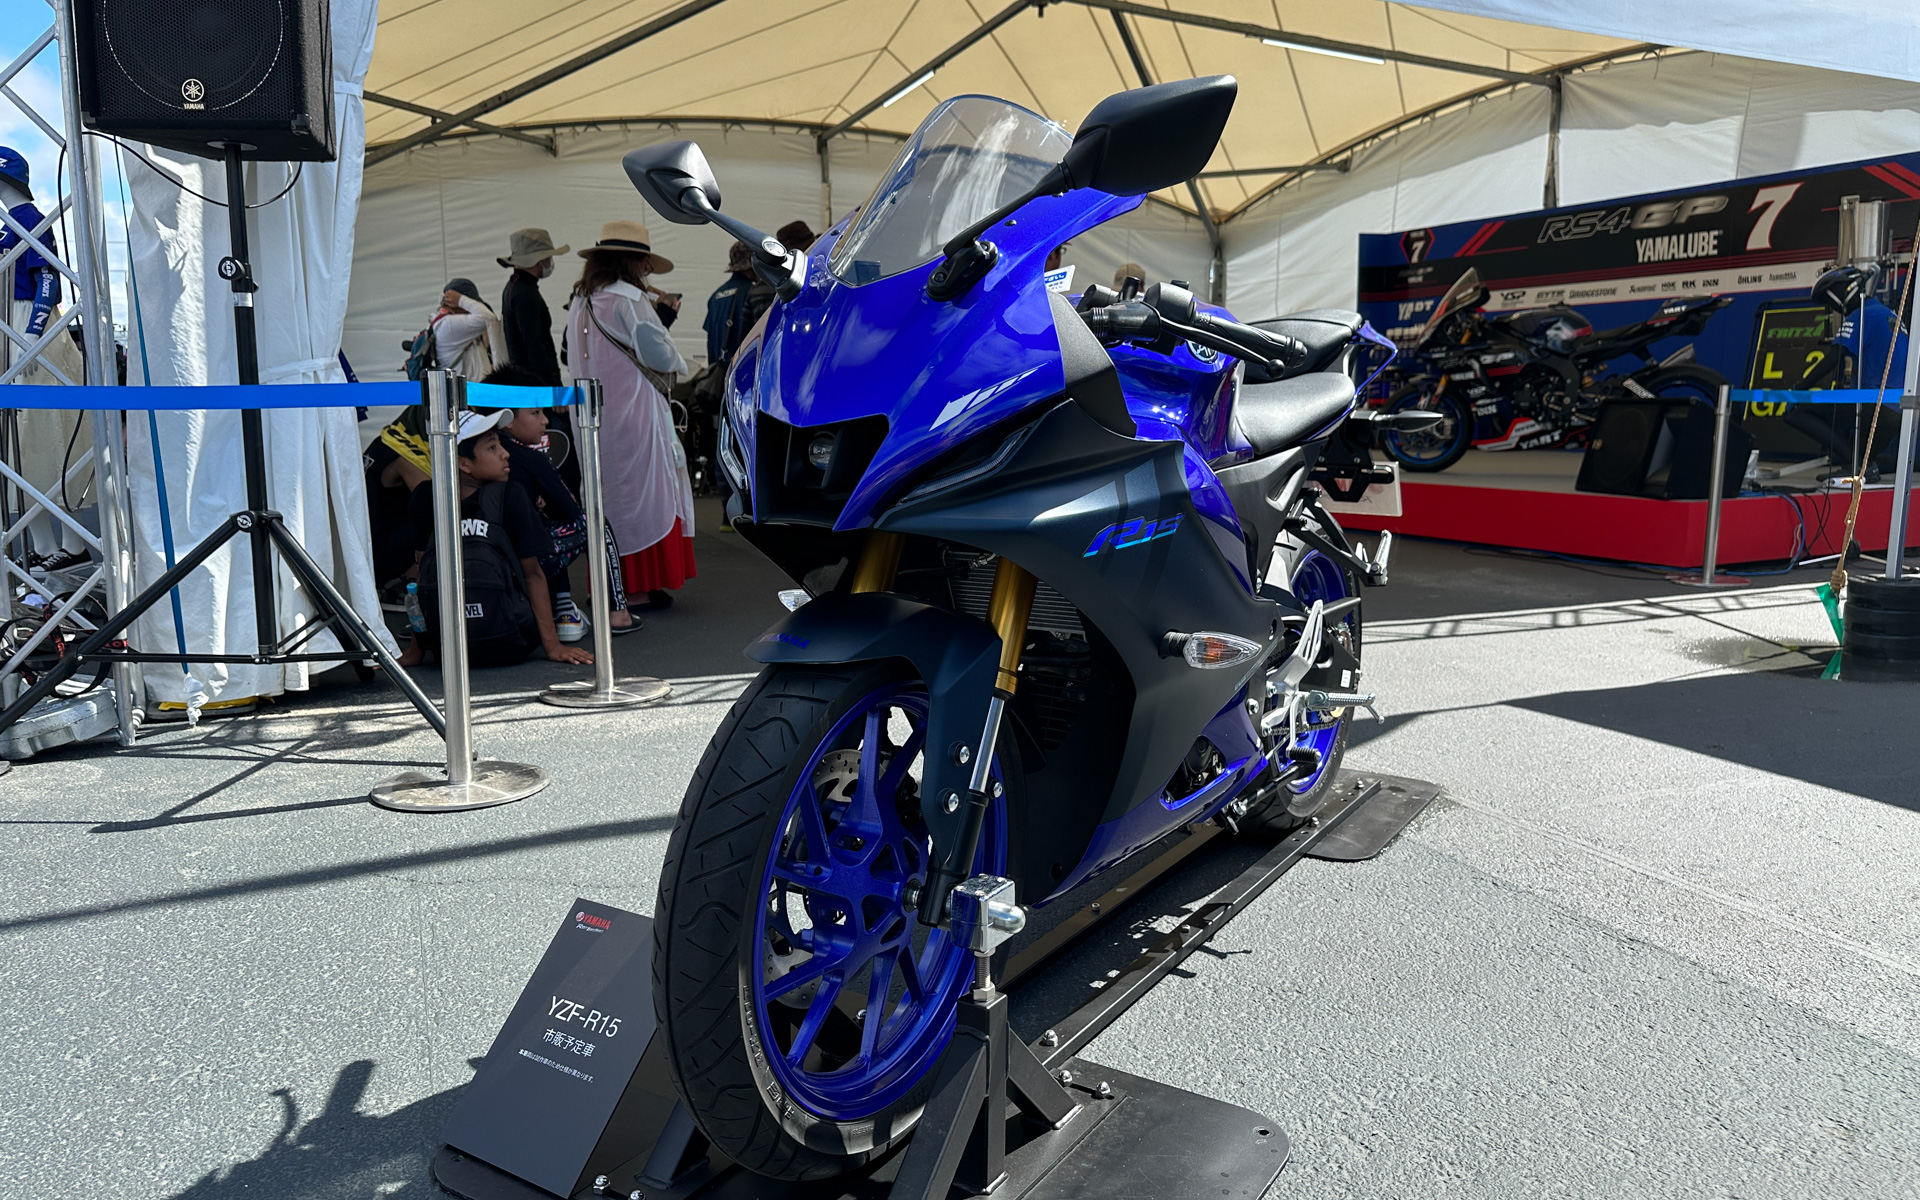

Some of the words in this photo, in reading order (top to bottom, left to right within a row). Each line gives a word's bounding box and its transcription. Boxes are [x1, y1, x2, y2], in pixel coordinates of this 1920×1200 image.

[1745, 181, 1804, 251] 7
[1410, 240, 1425, 264] 7
[1636, 229, 1718, 263] YAMALUBE
[1569, 287, 1618, 299] BRIDGESTONE
[1763, 352, 1783, 380] L
[1519, 429, 1563, 450] YART
[461, 518, 488, 538] RVEL
[584, 914, 611, 930] YAMAHA
[547, 995, 621, 1038] YZF-R15
[543, 1028, 596, 1058] 市販予定車
